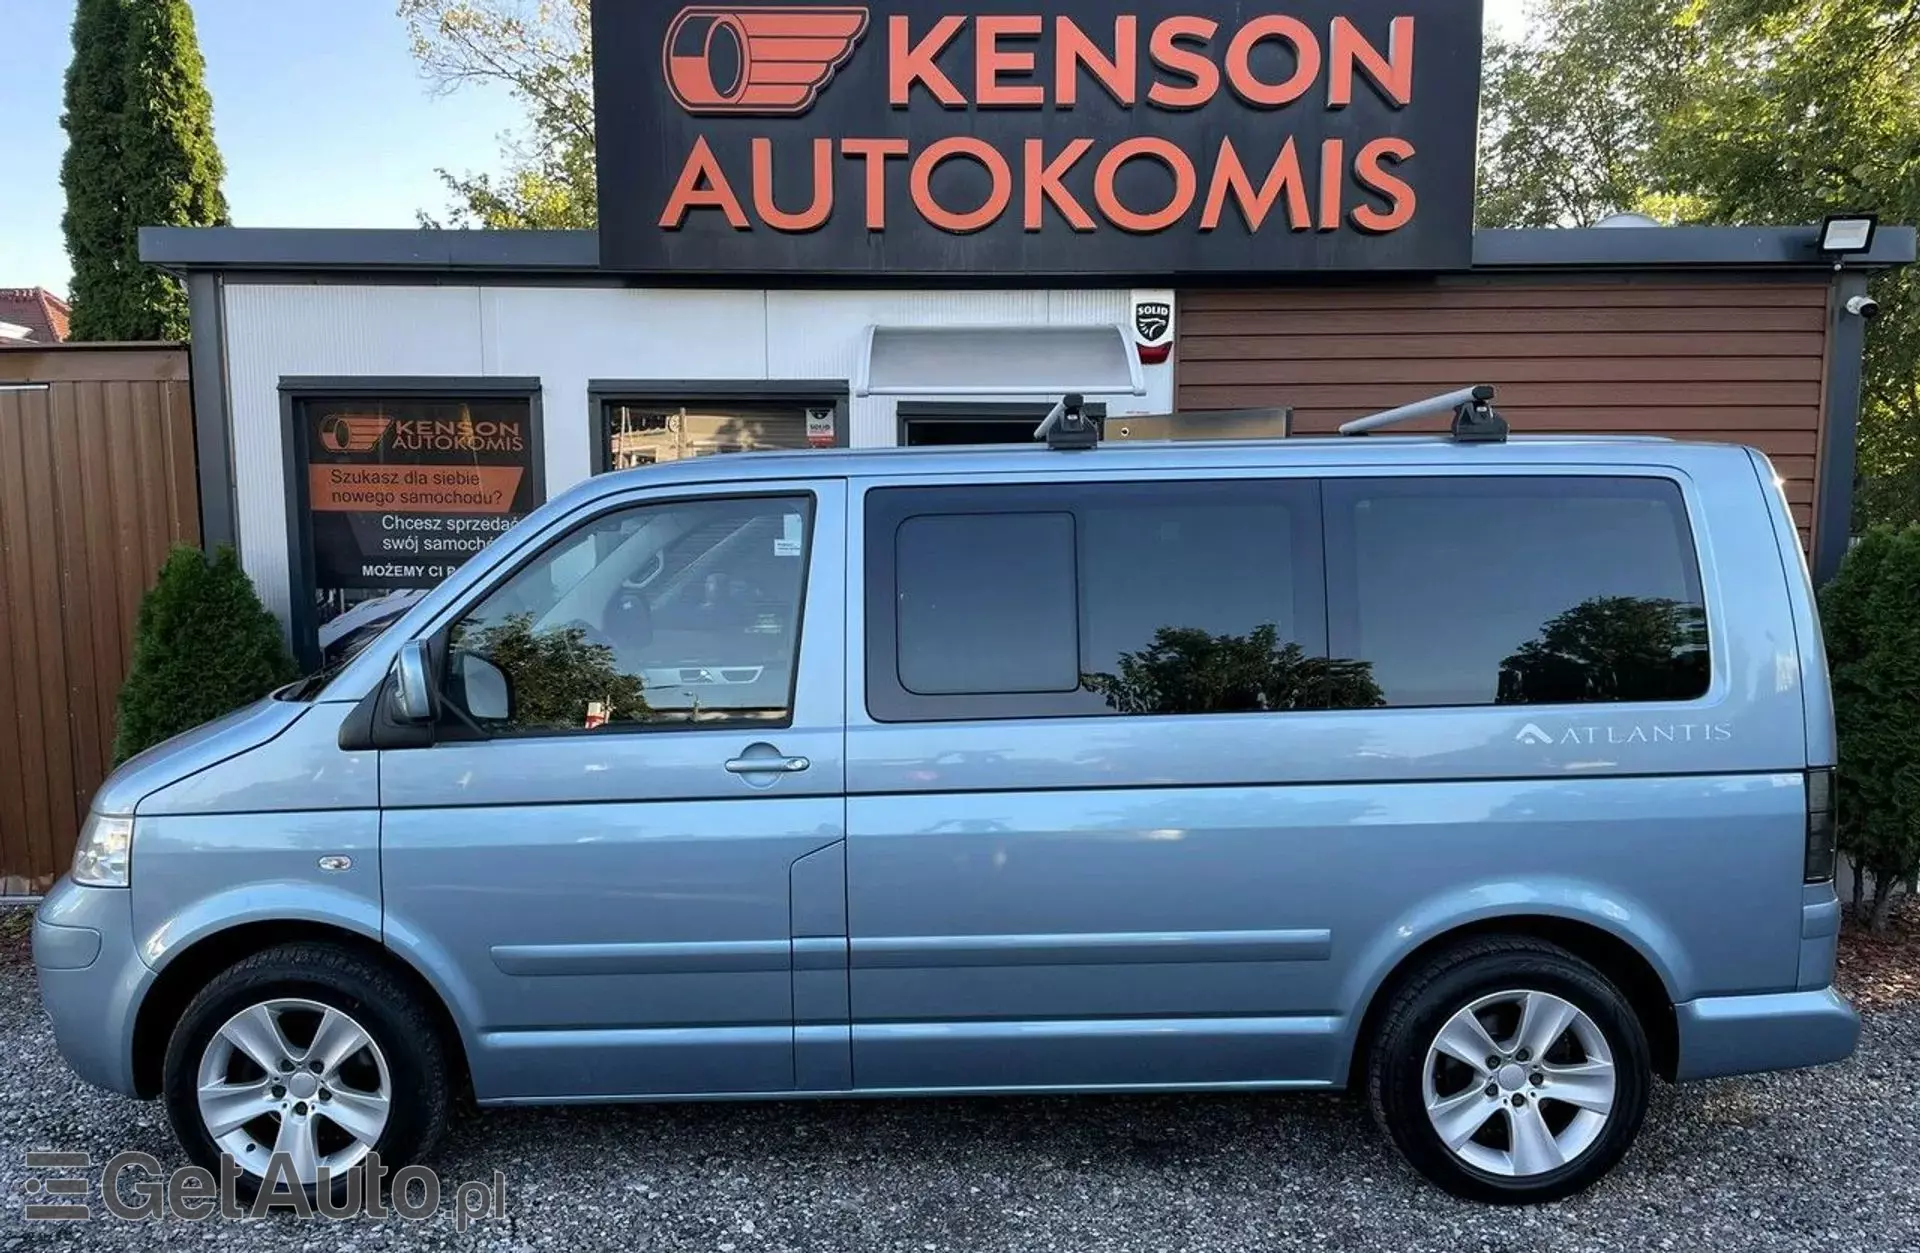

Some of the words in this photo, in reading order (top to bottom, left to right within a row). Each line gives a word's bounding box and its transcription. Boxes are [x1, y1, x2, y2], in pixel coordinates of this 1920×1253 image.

[888, 14, 1415, 109] KENSON
[658, 134, 1417, 233] AUTOKOMIS
[1138, 306, 1168, 316] SOLID
[396, 420, 519, 436] KENSON
[392, 435, 524, 450] AUTOKOMIS
[331, 469, 400, 484] Szukasz
[404, 469, 428, 484] dla
[433, 470, 480, 485] siebie
[332, 491, 394, 506] nowego
[400, 490, 502, 505] samochodu?
[382, 515, 442, 531] Chcesz
[382, 537, 419, 553] swój
[362, 562, 425, 577] MOŻEMY
[428, 566, 443, 577] CI
[1560, 723, 1732, 745] ATLANTIS
